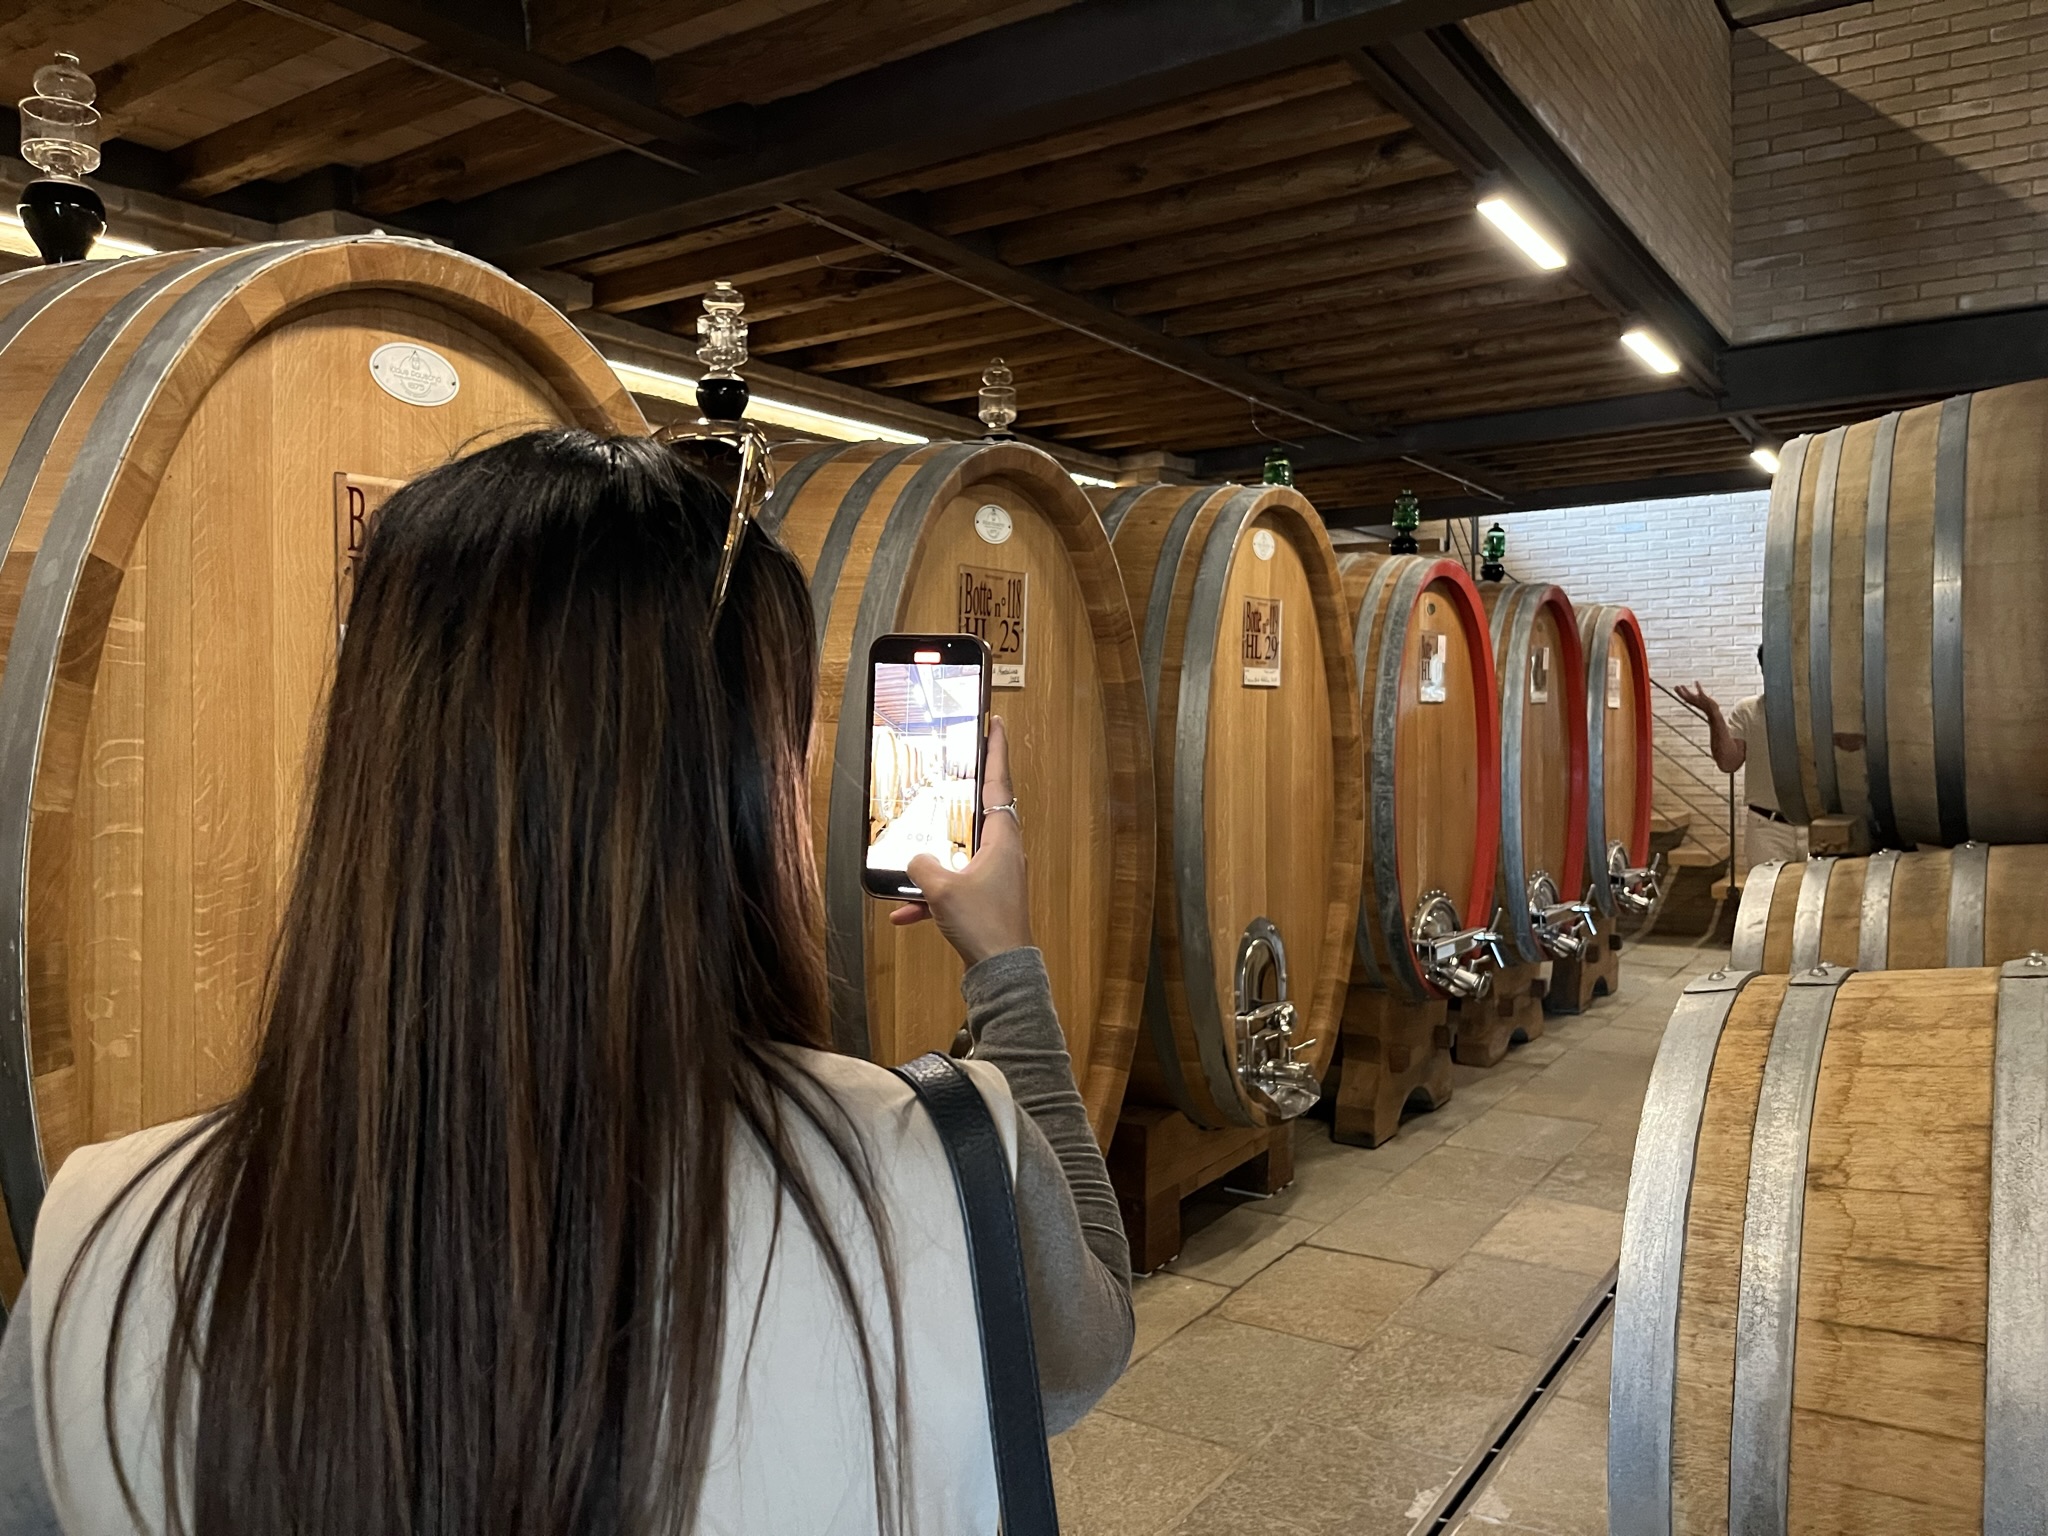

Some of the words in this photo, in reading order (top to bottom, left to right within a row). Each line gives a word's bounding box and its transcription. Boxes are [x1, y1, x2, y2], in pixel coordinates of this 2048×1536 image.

[964, 573, 993, 616] Botte
[1006, 579, 1022, 619] 118
[1245, 601, 1262, 633] Botte
[999, 620, 1021, 653] 25
[1245, 634, 1262, 660] HL
[1264, 635, 1279, 660] 29
